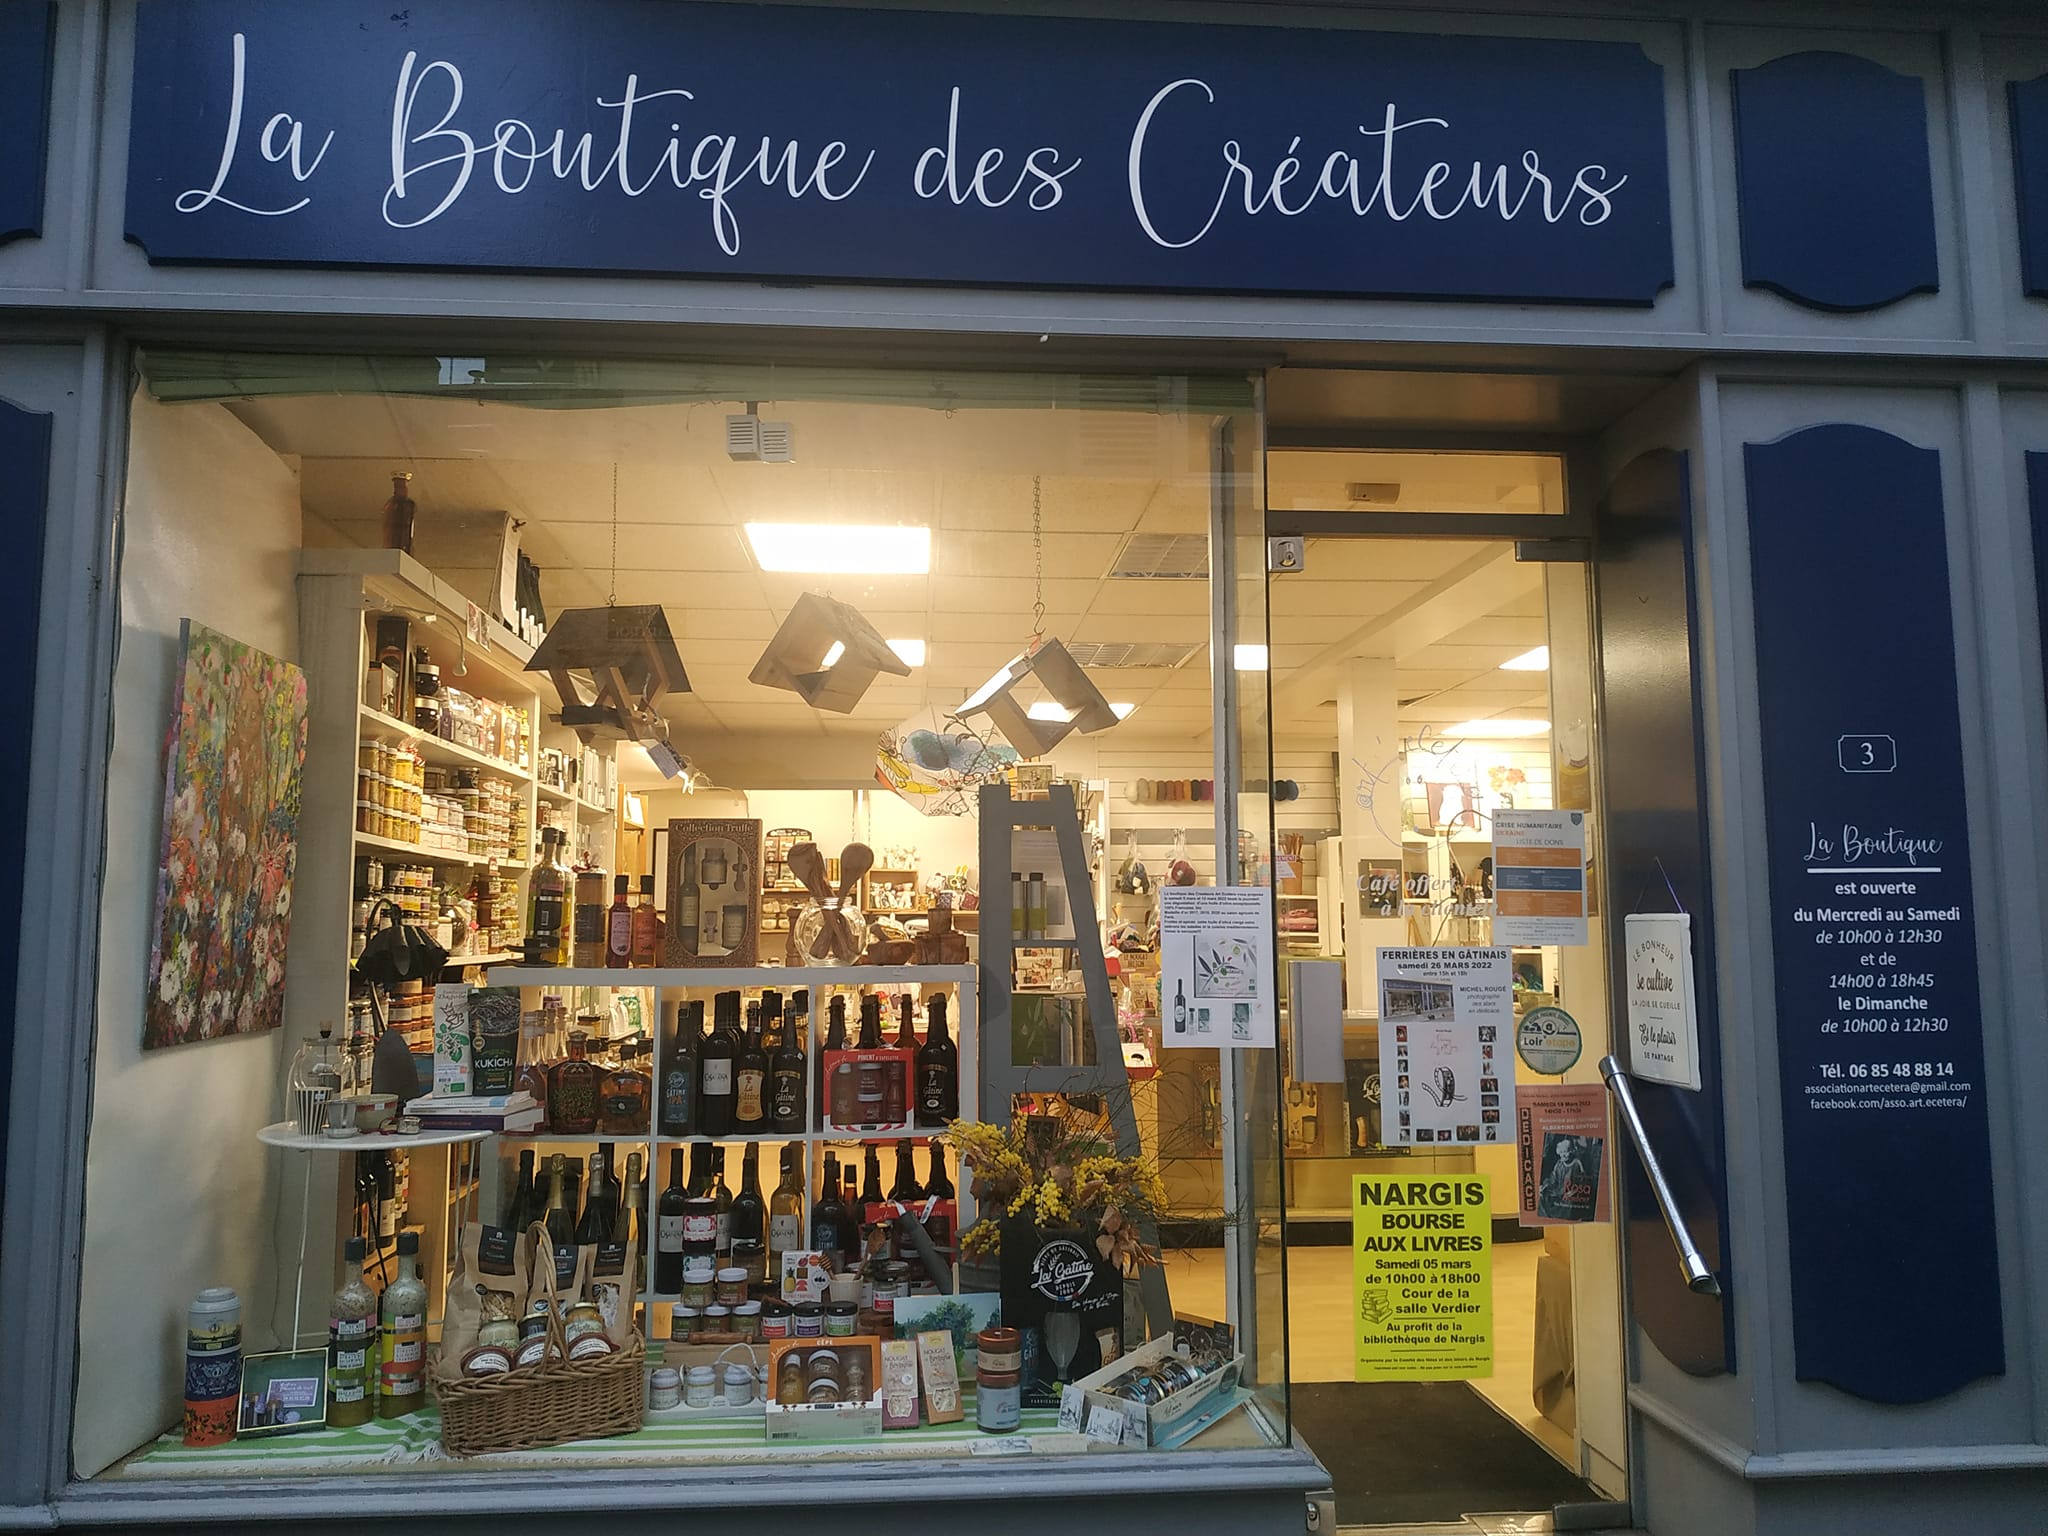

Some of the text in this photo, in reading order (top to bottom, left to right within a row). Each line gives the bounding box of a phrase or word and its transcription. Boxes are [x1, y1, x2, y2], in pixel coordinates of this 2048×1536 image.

[176, 33, 1628, 256] La Boutique des Créateurs
[1861, 742, 1874, 765] 3
[1804, 822, 1943, 865] La Boutique
[1357, 873, 1399, 894] Café
[1835, 882, 1916, 895] est ouverte
[1794, 907, 1960, 922] du Mercredi au Samedi
[1815, 929, 1942, 945] de 10h00 à 12h30
[1382, 948, 1507, 960] FERRIÈRES EN GÂTINAIS
[1641, 939, 1675, 962] BONHEUR
[1397, 962, 1429, 970] samedi
[1471, 961, 1492, 969] 2022
[1860, 952, 1897, 966] et de
[1646, 968, 1674, 992] cultive
[1829, 973, 1935, 988] 14h00 à 18h45
[1838, 997, 1928, 1011] le Dimanche
[1821, 1018, 1949, 1033] de 10h00 à 12h30
[474, 1057, 513, 1069] KUKICHA
[1651, 1052, 1674, 1063] PARTAGE
[1820, 1063, 1954, 1078] Tél. 06 85 48 88 14
[1804, 1081, 1971, 1094] associationartecetera@gmail.com
[1810, 1096, 1967, 1110] facebook.com/asso.art.ecetera/
[1360, 1182, 1485, 1206] NARGIS
[1382, 1213, 1465, 1229] BOURSE
[1363, 1235, 1483, 1252] AUX LIVRES
[1375, 1259, 1471, 1269] Samedi 05 mars
[1031, 1259, 1095, 1289] La Gâtine
[1365, 1273, 1480, 1284] de 10h00 à 18h00
[1402, 1288, 1469, 1299] Cour de la
[1396, 1303, 1480, 1314] salle Verdier
[1386, 1322, 1462, 1333] Au profit de la
[1363, 1334, 1485, 1346] bibliothèque de Nargis
